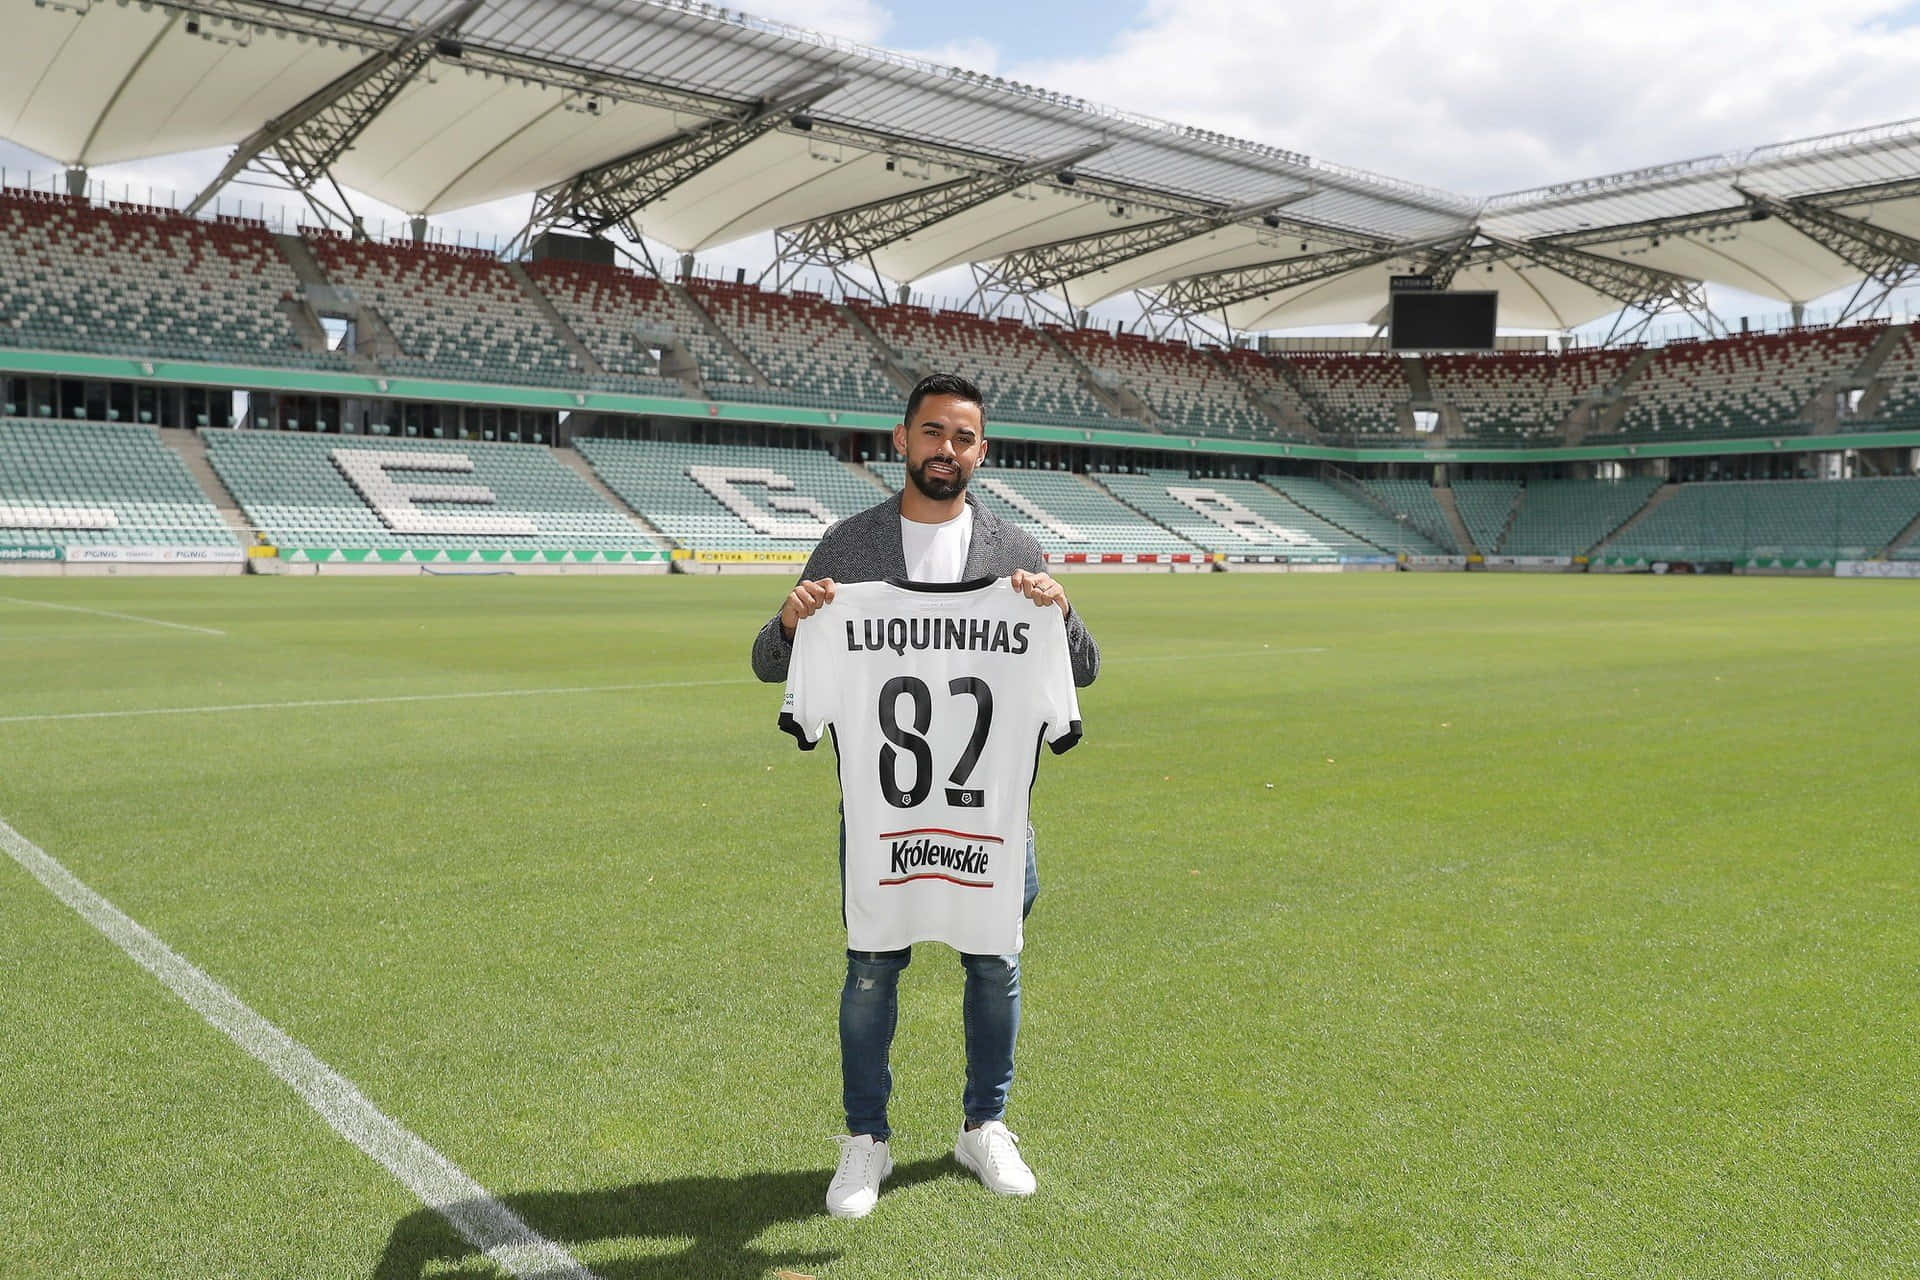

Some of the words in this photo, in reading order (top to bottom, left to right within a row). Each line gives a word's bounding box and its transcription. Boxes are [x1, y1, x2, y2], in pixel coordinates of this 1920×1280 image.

[846, 618, 1030, 656] LUQUINHAS
[878, 675, 994, 809] 82
[891, 839, 989, 875] Królewskie
